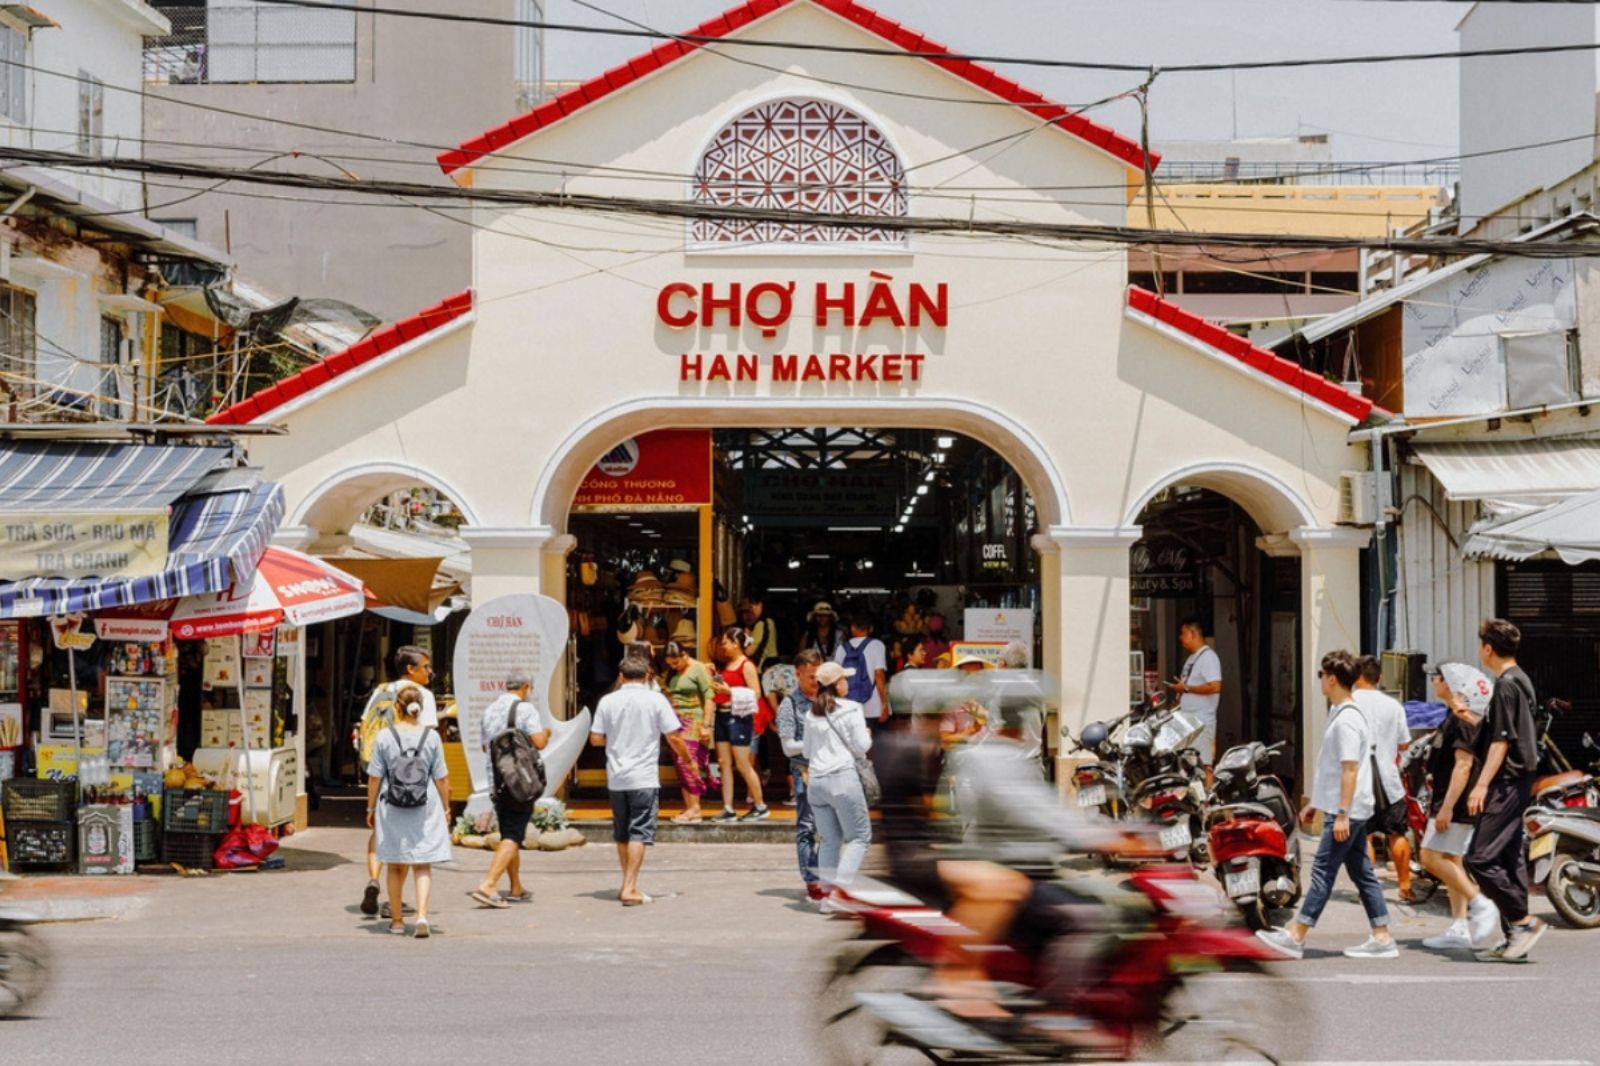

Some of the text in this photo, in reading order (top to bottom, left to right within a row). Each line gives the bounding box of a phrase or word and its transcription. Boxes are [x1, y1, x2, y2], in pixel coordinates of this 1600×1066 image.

[656, 270, 948, 338] CHỢ HÀN
[680, 354, 925, 381] HAN MARKET
[580, 480, 618, 489] CÔNG
[92, 525, 124, 541] RAU
[71, 552, 128, 570] CHANH
